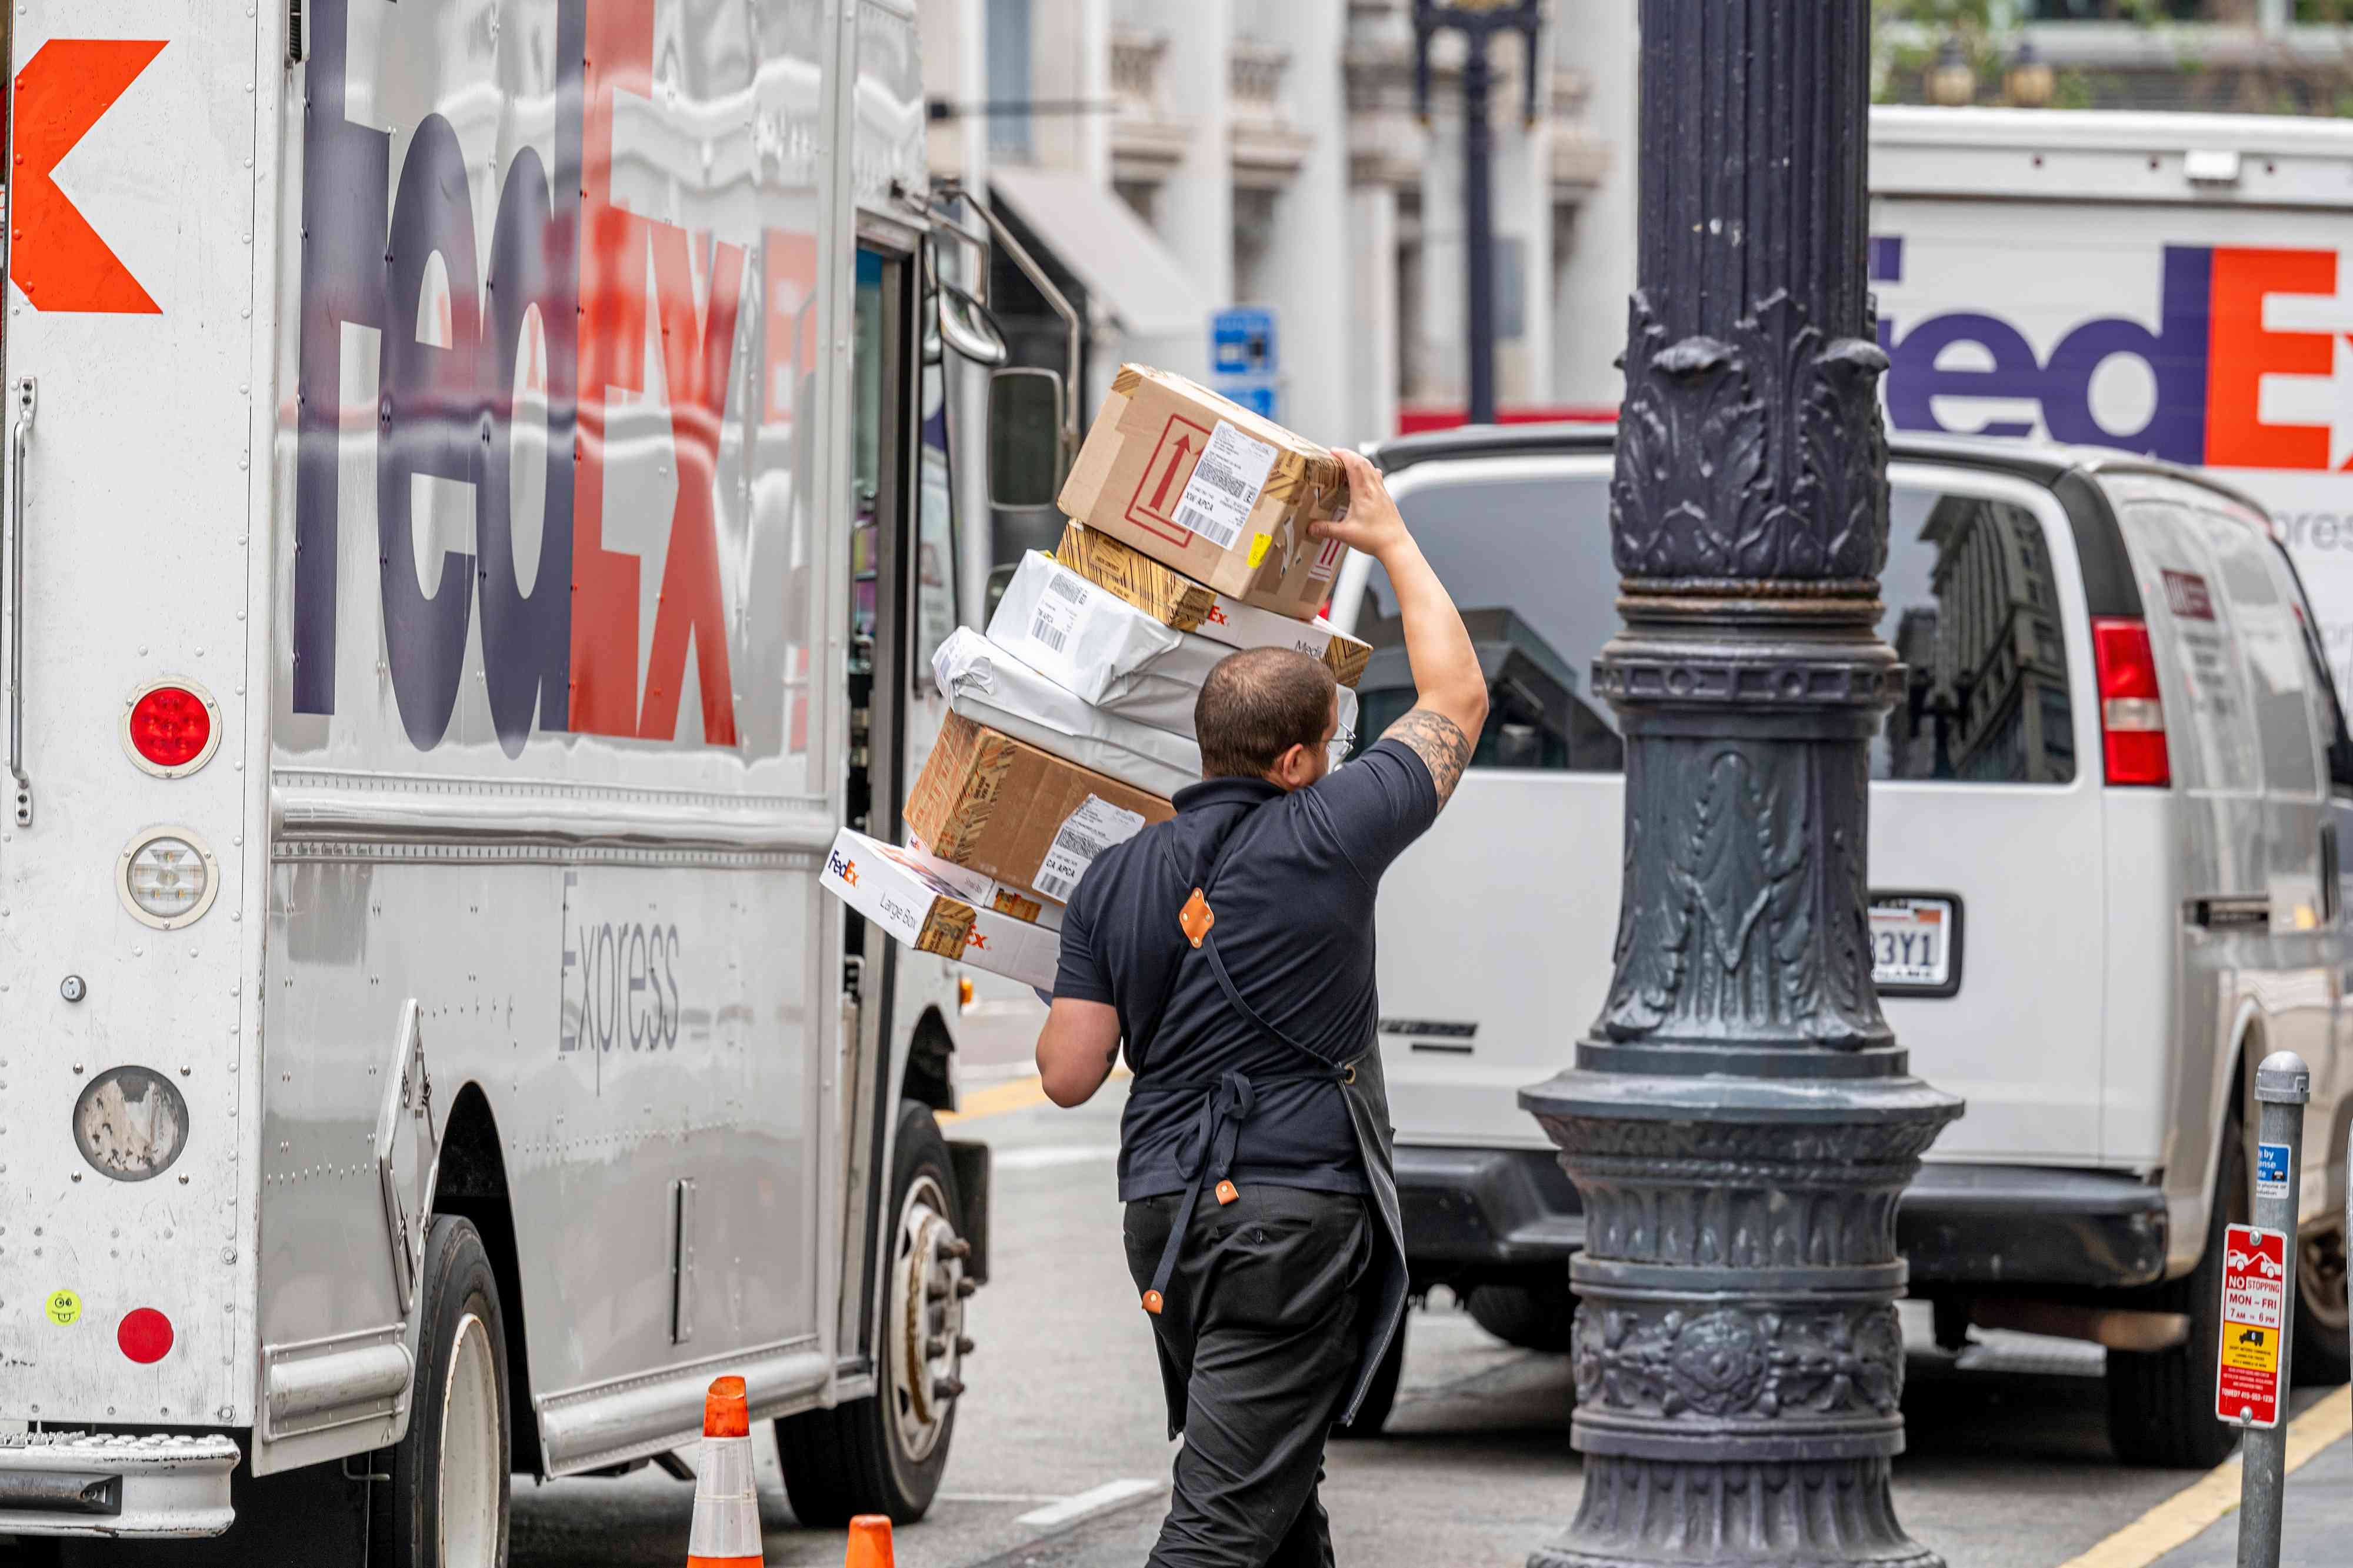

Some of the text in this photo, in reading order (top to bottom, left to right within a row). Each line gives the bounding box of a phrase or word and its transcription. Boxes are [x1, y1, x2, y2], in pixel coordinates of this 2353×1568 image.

[1869, 236, 2353, 469] edE
[828, 850, 859, 888] FedEx
[879, 890, 919, 932] Large Box
[1872, 931, 1931, 966] 3Y1
[559, 872, 679, 1097] Express
[2264, 1148, 2274, 1160] by
[2229, 1275, 2279, 1293] NO STOPPING
[2229, 1293, 2252, 1306] MON
[2262, 1298, 2277, 1310] FRI
[2230, 1307, 2235, 1317] 7
[2236, 1312, 2245, 1320] AM
